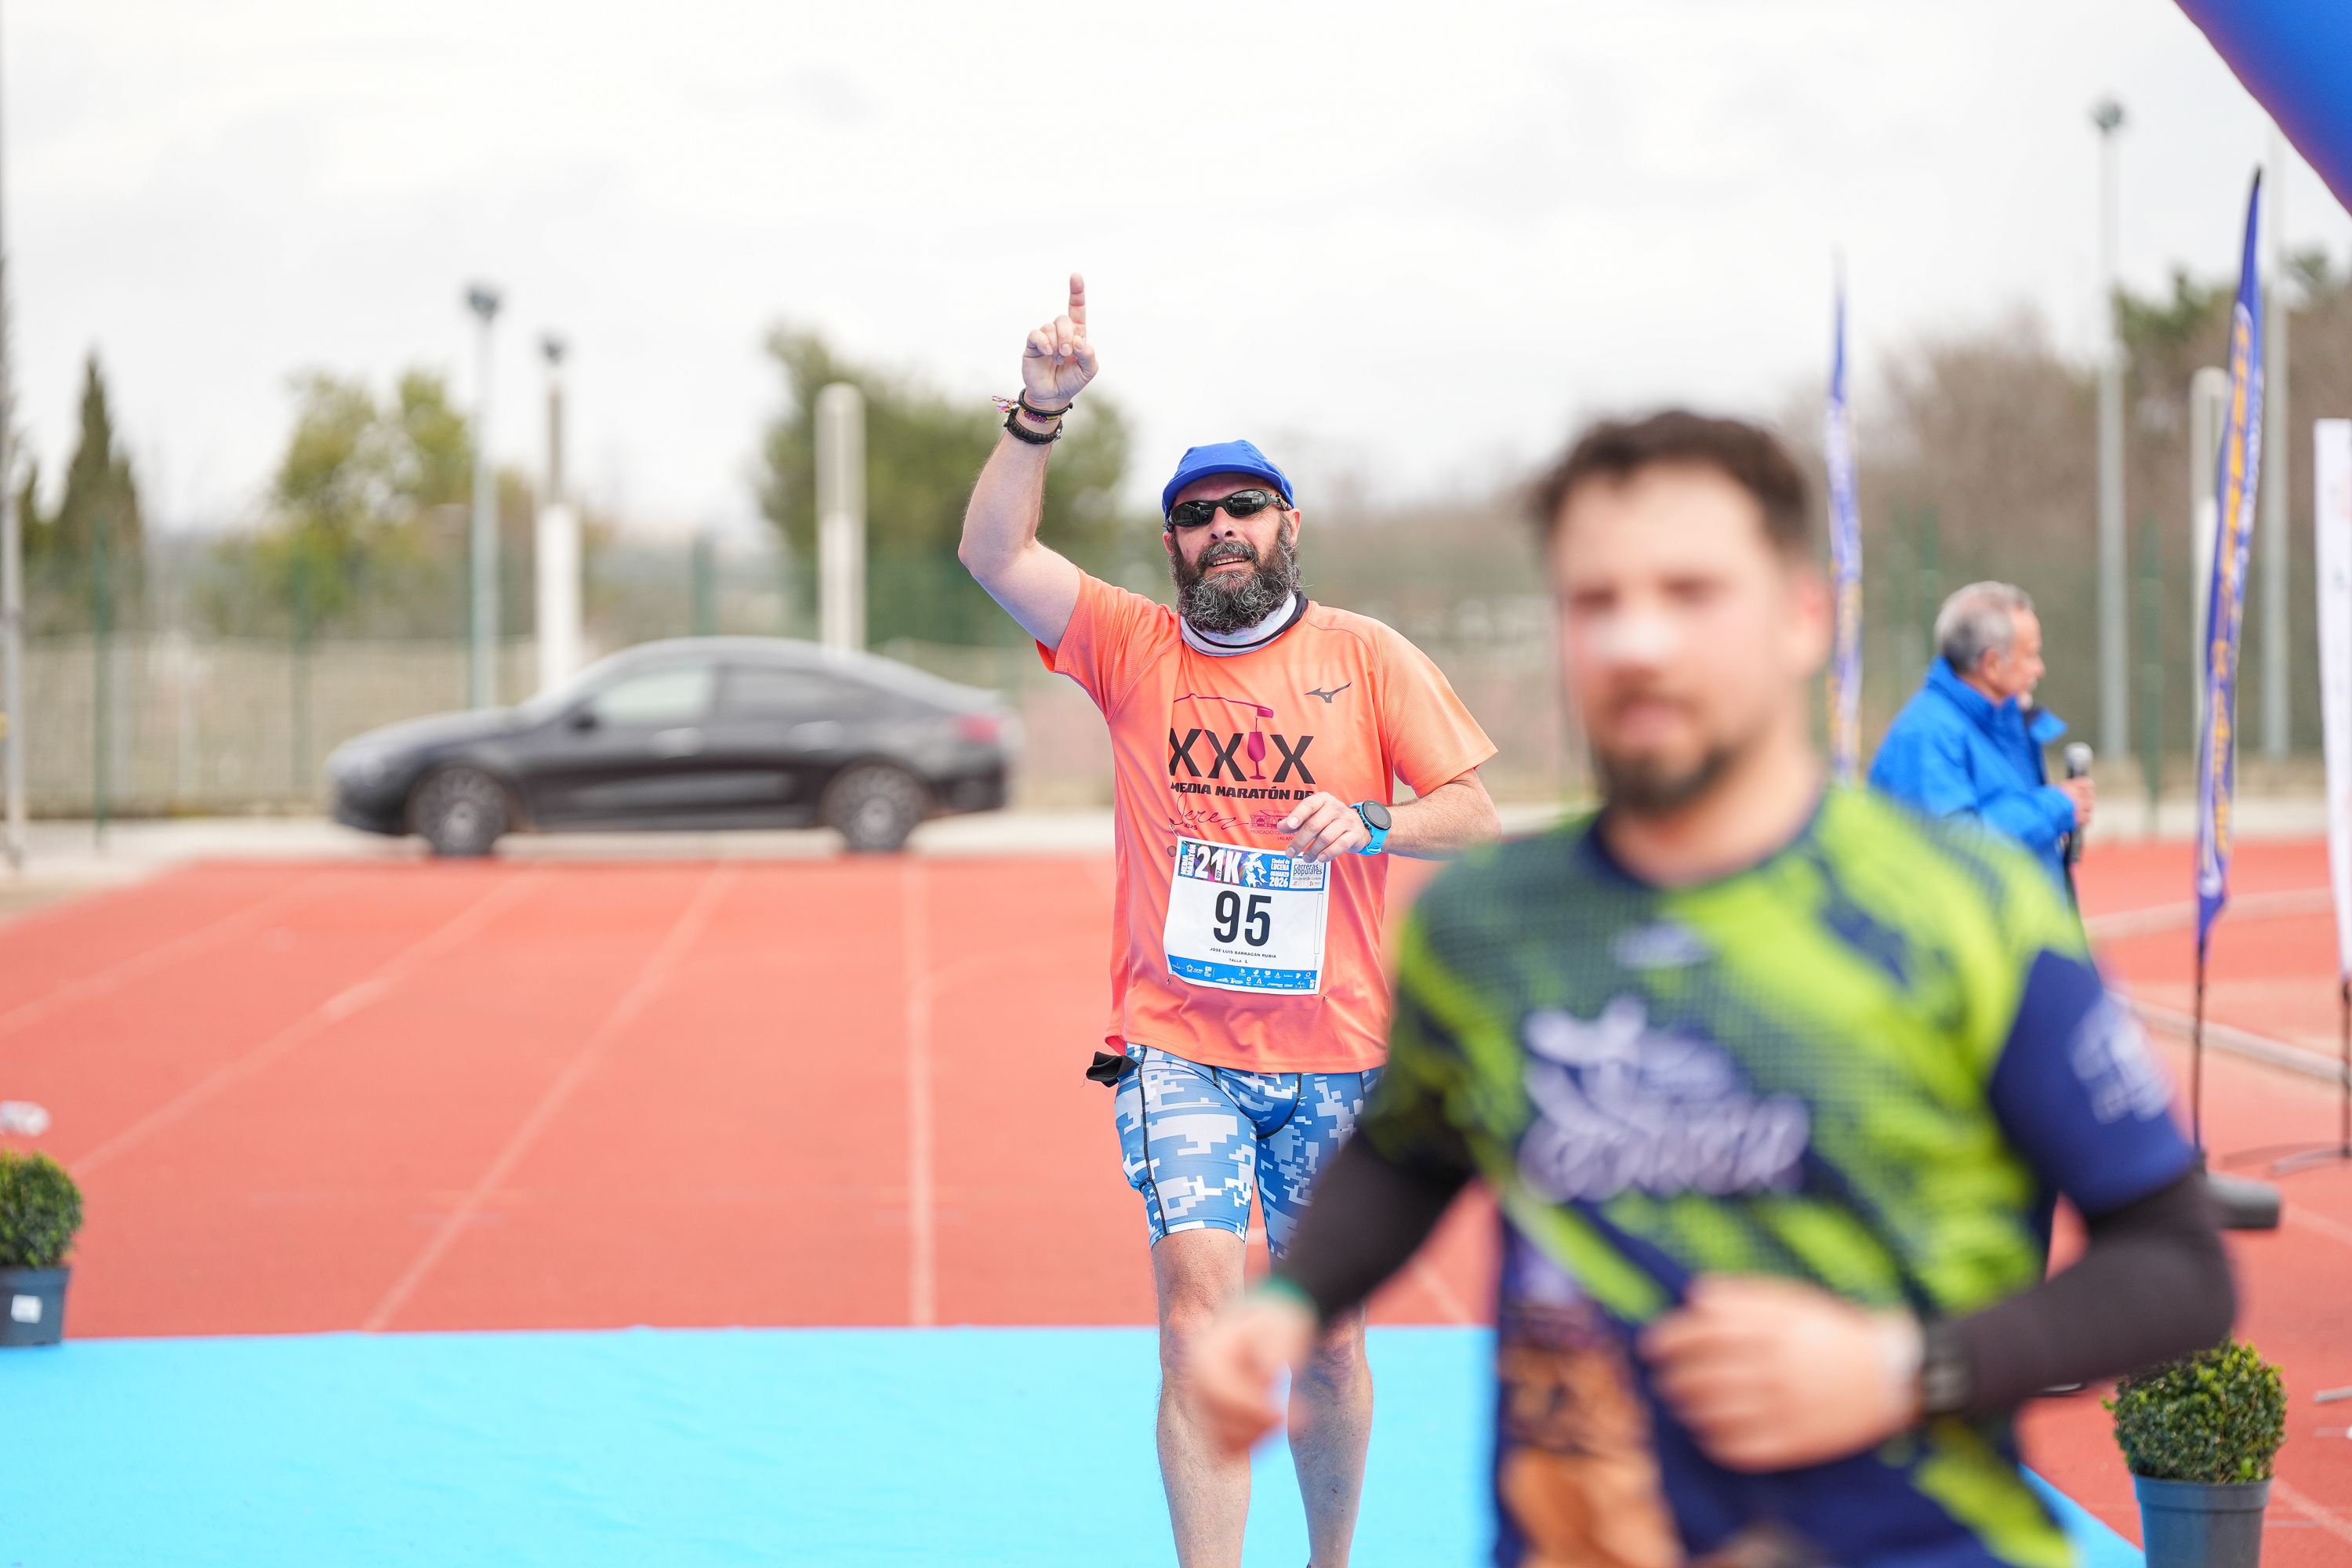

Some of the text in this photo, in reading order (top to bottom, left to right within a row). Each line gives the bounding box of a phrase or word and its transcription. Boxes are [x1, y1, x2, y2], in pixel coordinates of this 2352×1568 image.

[1171, 782, 1315, 800] MEDIA MARATÓN DE
[1195, 845, 1243, 884] 21K
[1269, 877, 1289, 887] 2026
[1213, 890, 1272, 946] 95
